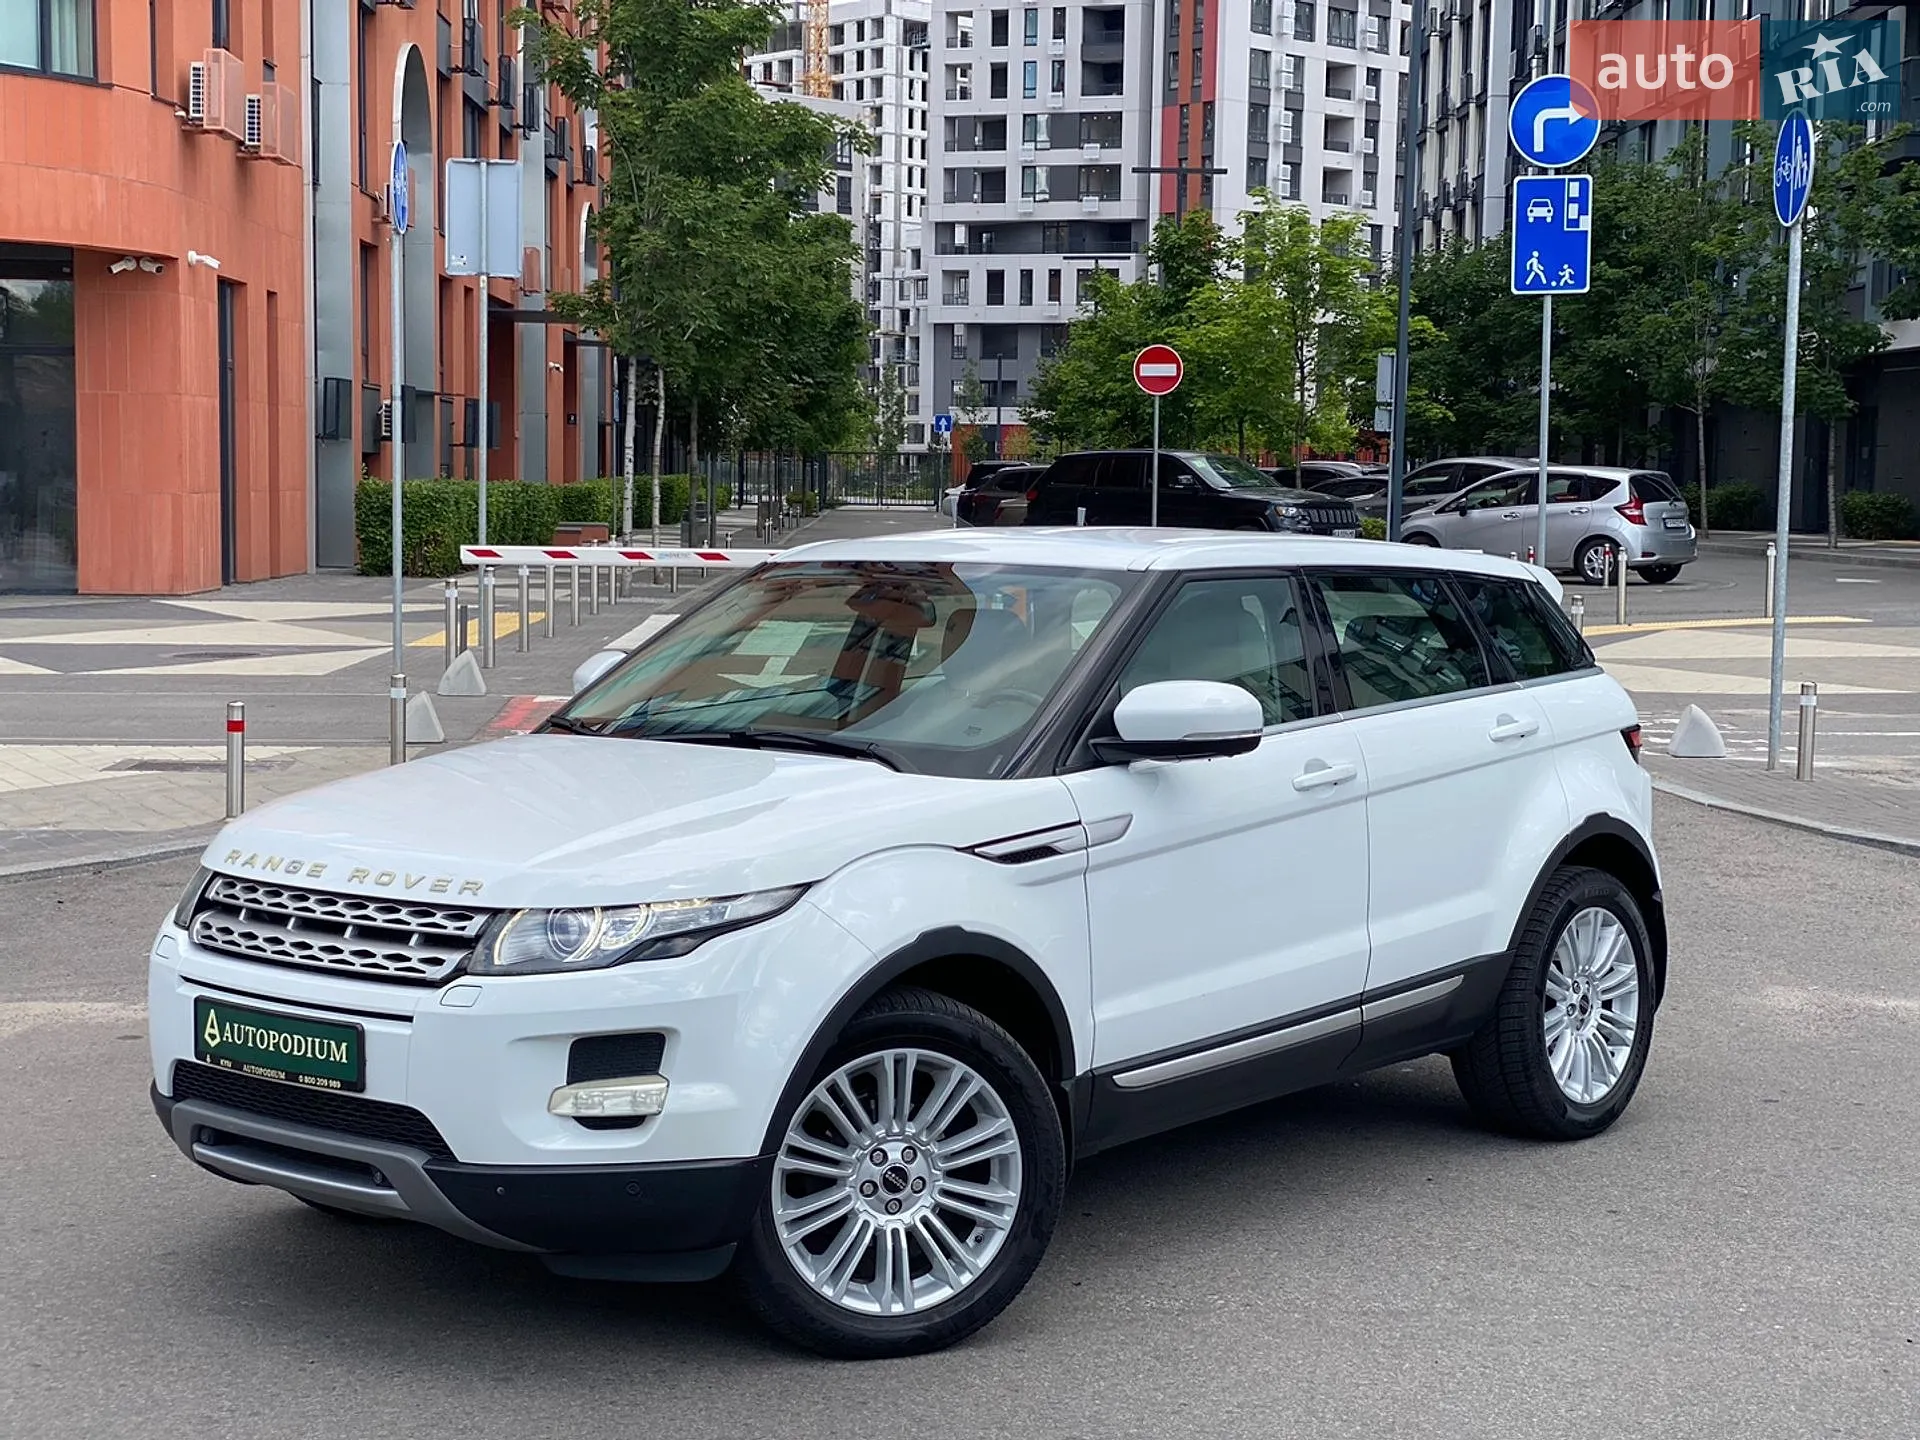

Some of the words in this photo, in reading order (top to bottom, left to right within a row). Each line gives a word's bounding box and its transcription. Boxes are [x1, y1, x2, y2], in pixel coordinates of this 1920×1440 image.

[224, 848, 327, 878] RANGE
[347, 866, 485, 896] ROVER
[223, 1021, 348, 1063] AUTOPODIUM
[243, 1064, 286, 1080] AUTOPODIUM
